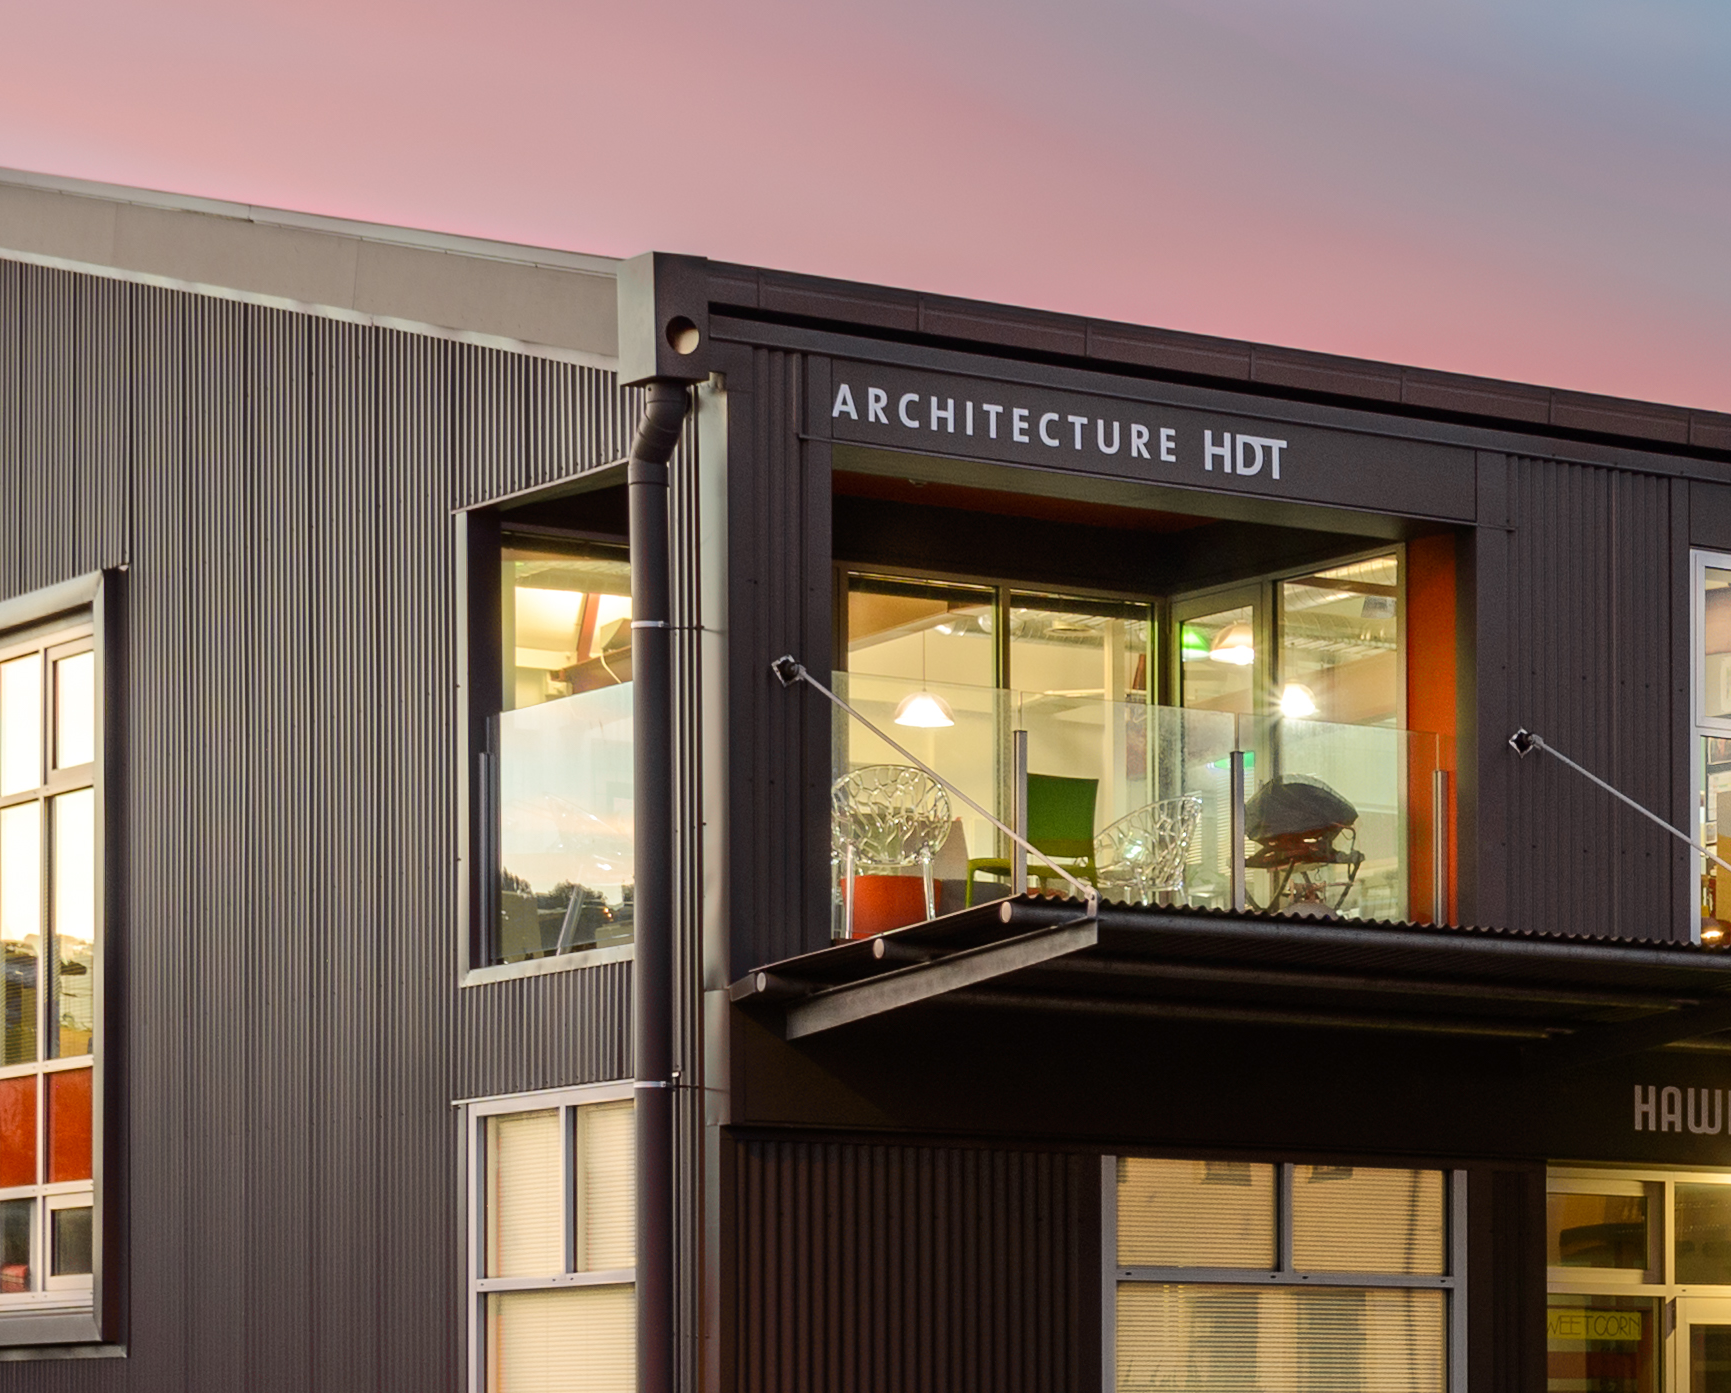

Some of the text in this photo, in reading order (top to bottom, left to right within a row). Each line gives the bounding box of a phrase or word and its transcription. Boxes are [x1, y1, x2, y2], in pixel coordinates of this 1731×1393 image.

[832, 383, 1288, 480] ARCHITECTURE HDT
[1547, 1314, 1641, 1337] WEETCORN
